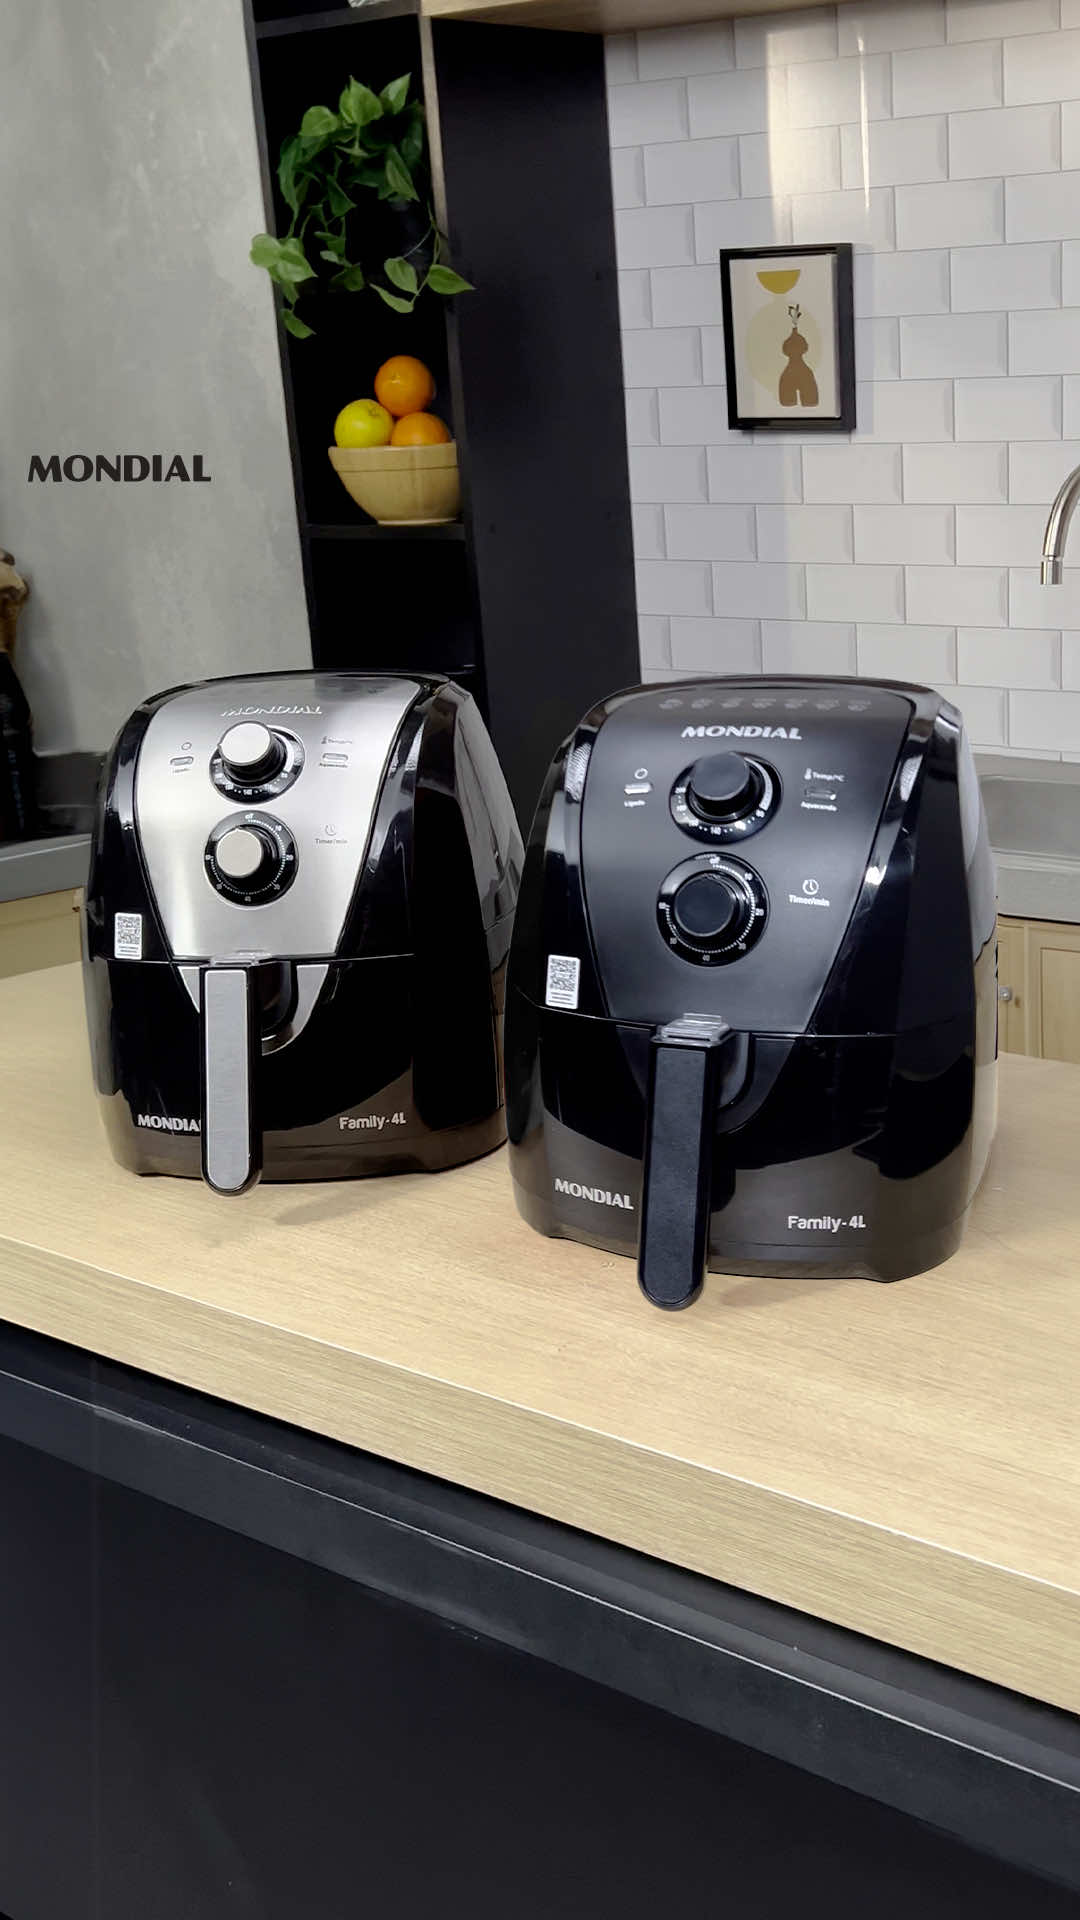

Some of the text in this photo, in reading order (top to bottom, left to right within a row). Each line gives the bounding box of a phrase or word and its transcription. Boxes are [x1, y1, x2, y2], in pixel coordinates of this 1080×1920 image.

[220, 706, 322, 716] MONDIAL
[681, 725, 802, 740] MONDIAL
[137, 1114, 201, 1131] MONDIA
[554, 1178, 634, 1210] MONDIAL
